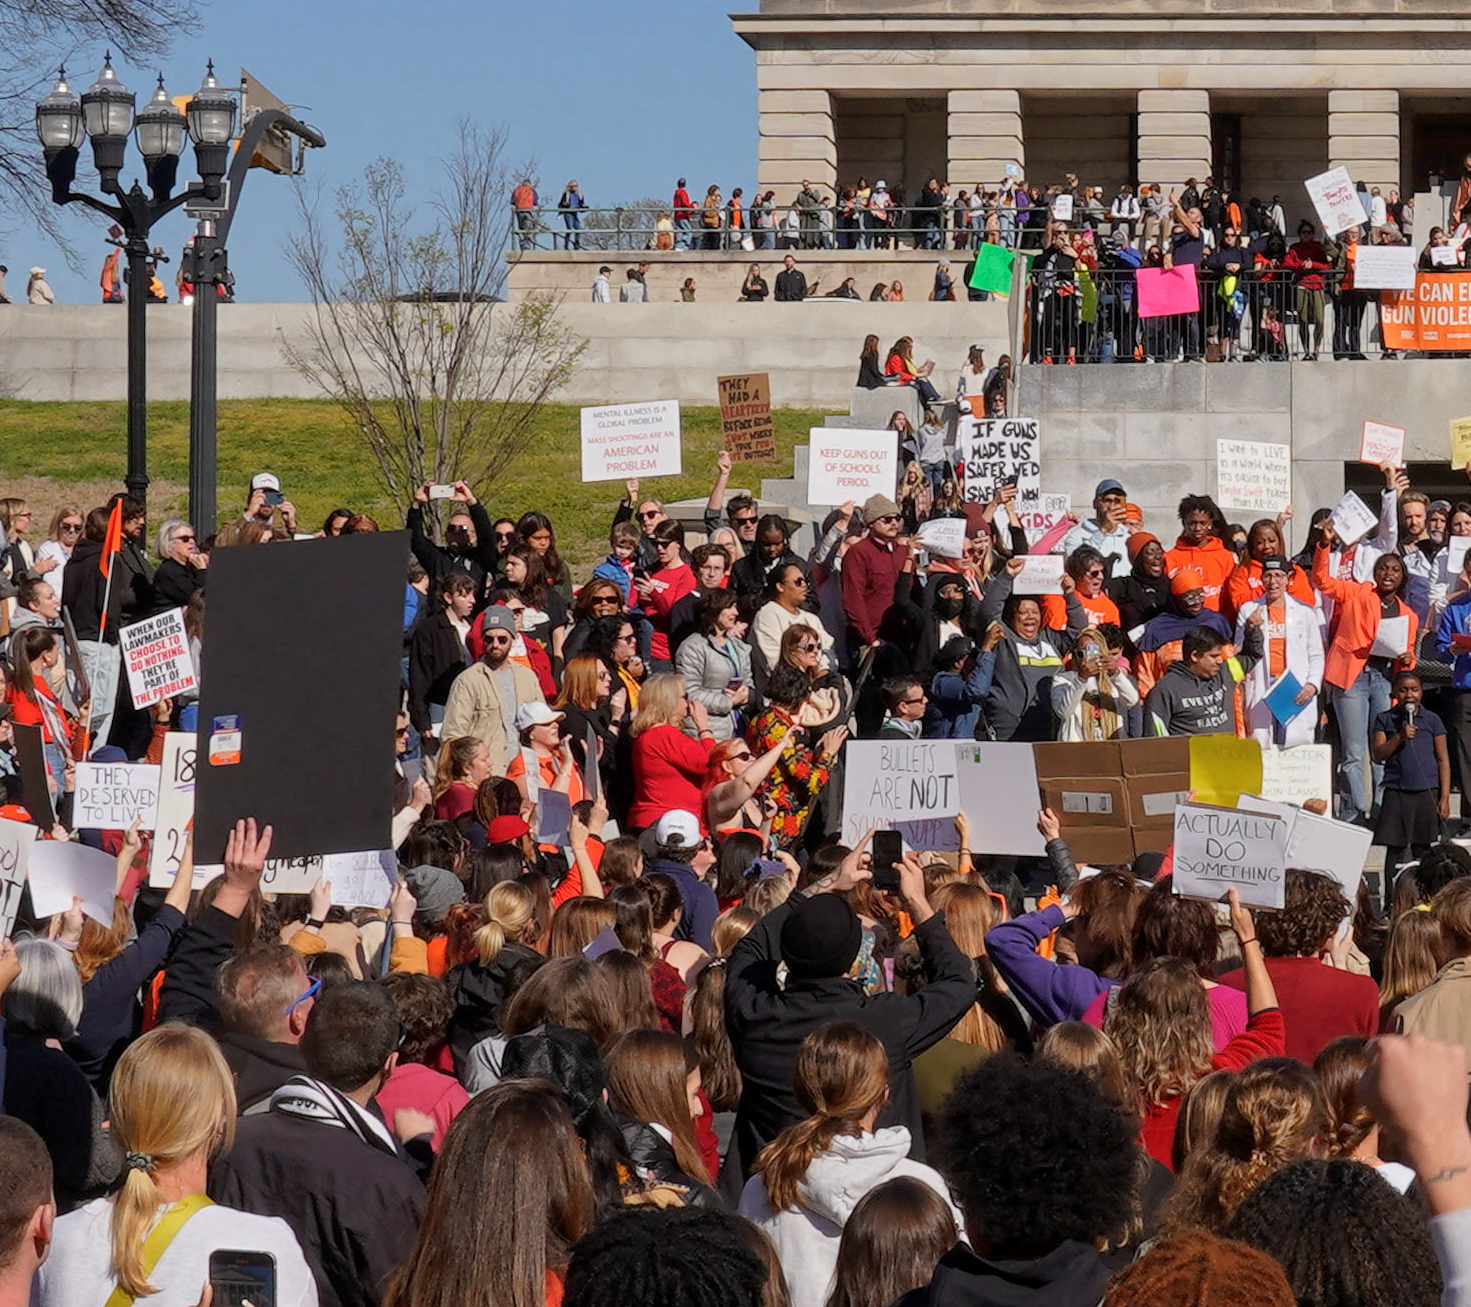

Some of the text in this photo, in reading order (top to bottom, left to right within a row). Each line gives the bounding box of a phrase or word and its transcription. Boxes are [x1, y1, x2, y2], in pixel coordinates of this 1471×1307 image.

[1420, 283, 1454, 302] CAN
[1382, 305, 1415, 324] GUN
[721, 377, 749, 391] THEY
[729, 390, 759, 404] HAD A
[624, 408, 652, 416] ILLNESS
[597, 417, 662, 429] GLOBAL PROBLEM
[972, 421, 1037, 440] IF GUNS
[610, 433, 648, 442] SHOOTINGS
[603, 445, 659, 458] AMERICAN
[820, 449, 889, 460] KEEP GUNS OUT
[972, 442, 1031, 460] MADE US
[1220, 443, 1287, 460] I want to LIVE
[606, 460, 657, 472] PROBLEM
[825, 463, 838, 472] OF
[967, 461, 1005, 478] SAFER
[1231, 461, 1237, 469] a
[837, 478, 870, 487] PERIOD.
[1235, 473, 1287, 487] easier to buy
[1233, 498, 1252, 508] than
[126, 614, 175, 639] WHEN OUR
[124, 623, 182, 651] LAWMAKERS
[130, 634, 180, 661] CHOOSE TO
[130, 659, 143, 672] DO
[142, 658, 177, 680] THEY'RE
[144, 669, 179, 690] PART OF
[135, 676, 194, 705] THE PROBLEM
[880, 744, 936, 774] BULLETS
[1278, 750, 1326, 759] DOCTOR
[91, 767, 134, 785] THEY
[80, 787, 155, 807] DESERVED
[870, 774, 954, 810] ARE NOT
[1288, 788, 1320, 796] LAWS
[82, 806, 104, 822] TO
[1177, 814, 1278, 840] ACTUALLY
[1205, 838, 1246, 861] DO
[1176, 857, 1280, 882] SOMETHING
